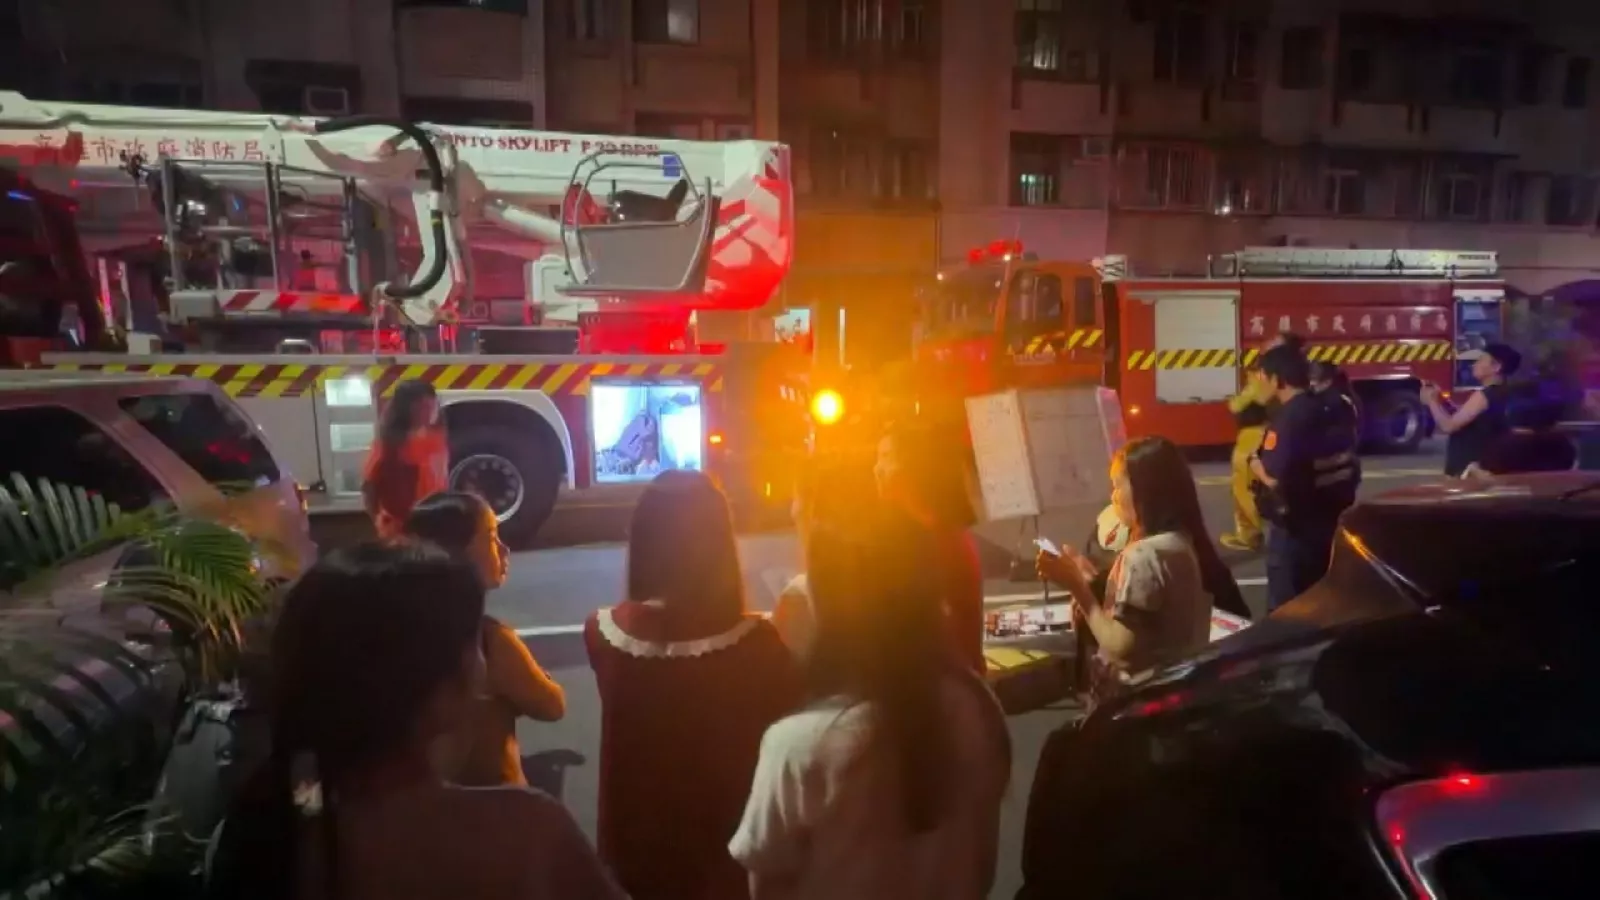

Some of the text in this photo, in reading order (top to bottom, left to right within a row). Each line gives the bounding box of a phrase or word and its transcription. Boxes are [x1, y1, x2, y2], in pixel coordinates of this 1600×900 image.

[35, 133, 263, 165] 高市政府消防局
[498, 136, 571, 153] SKYLIFT
